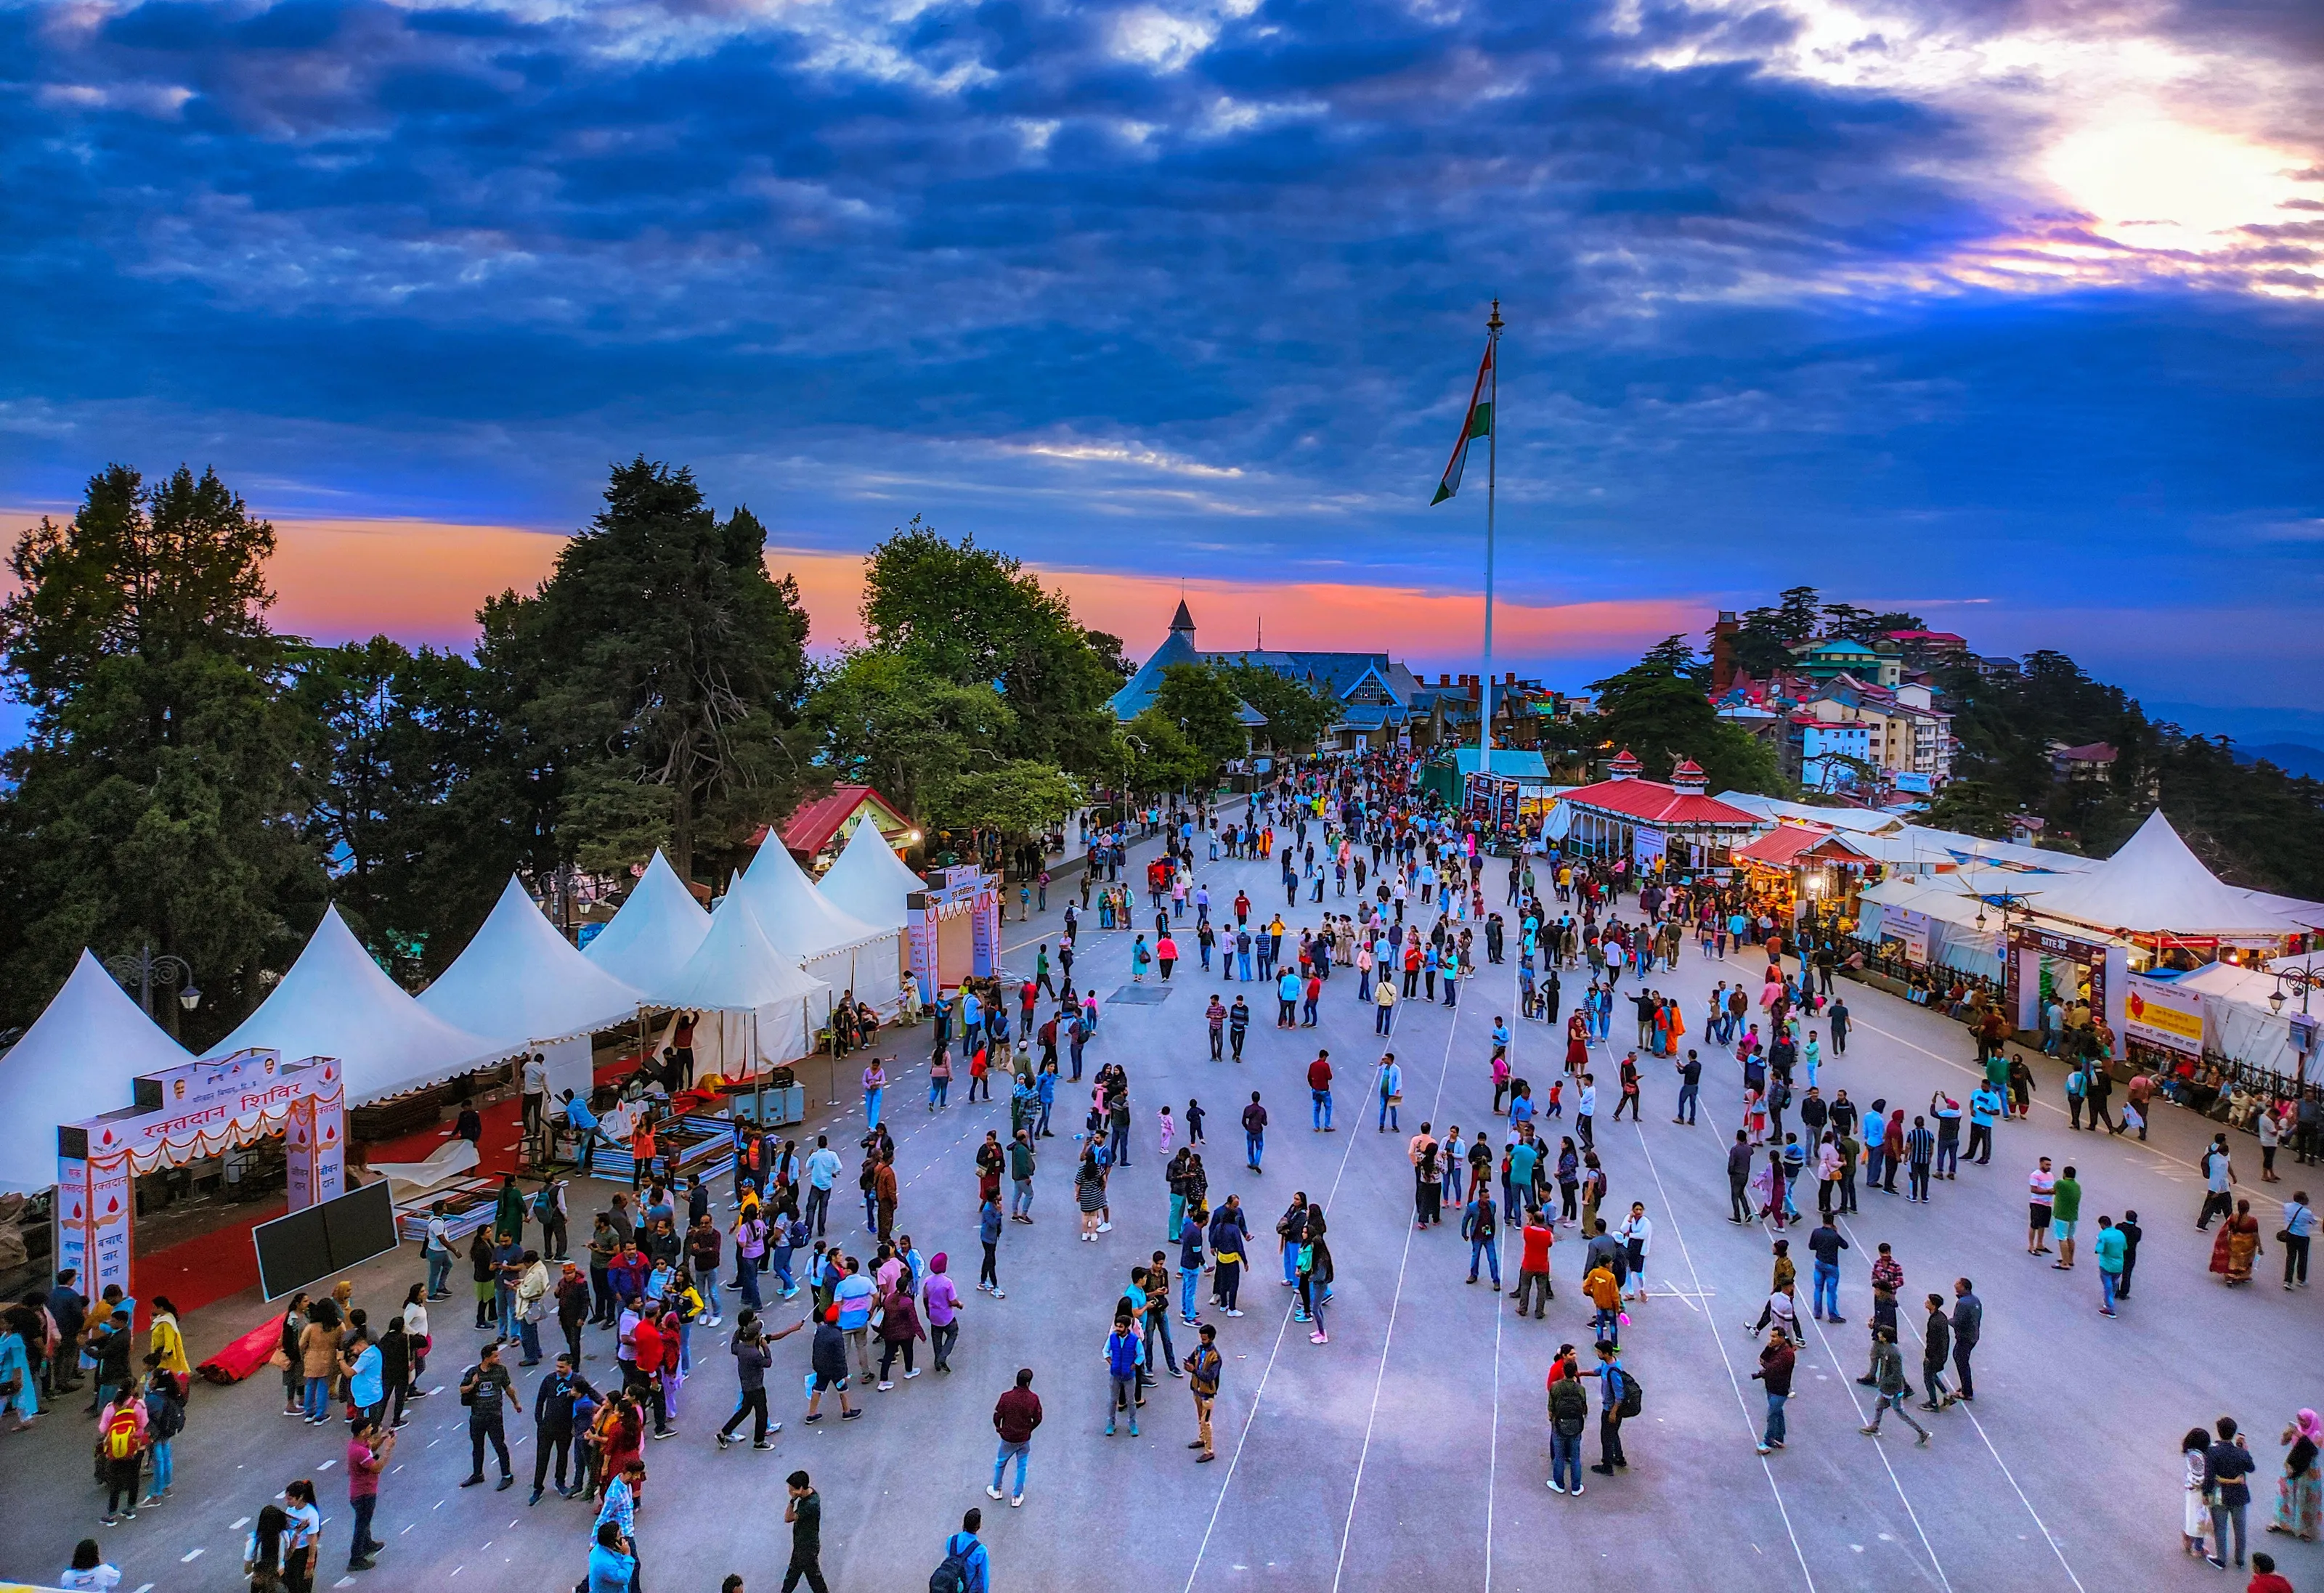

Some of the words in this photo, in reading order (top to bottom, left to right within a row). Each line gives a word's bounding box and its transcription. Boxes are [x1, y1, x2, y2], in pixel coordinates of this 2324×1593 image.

[143, 1105, 227, 1138] रक्तदान
[240, 1083, 302, 1112] शिविर
[320, 1163, 338, 1176] जीवन
[93, 1176, 128, 1194] रक्तदान
[322, 1178, 335, 1188] दान
[101, 1264, 119, 1277] जान
